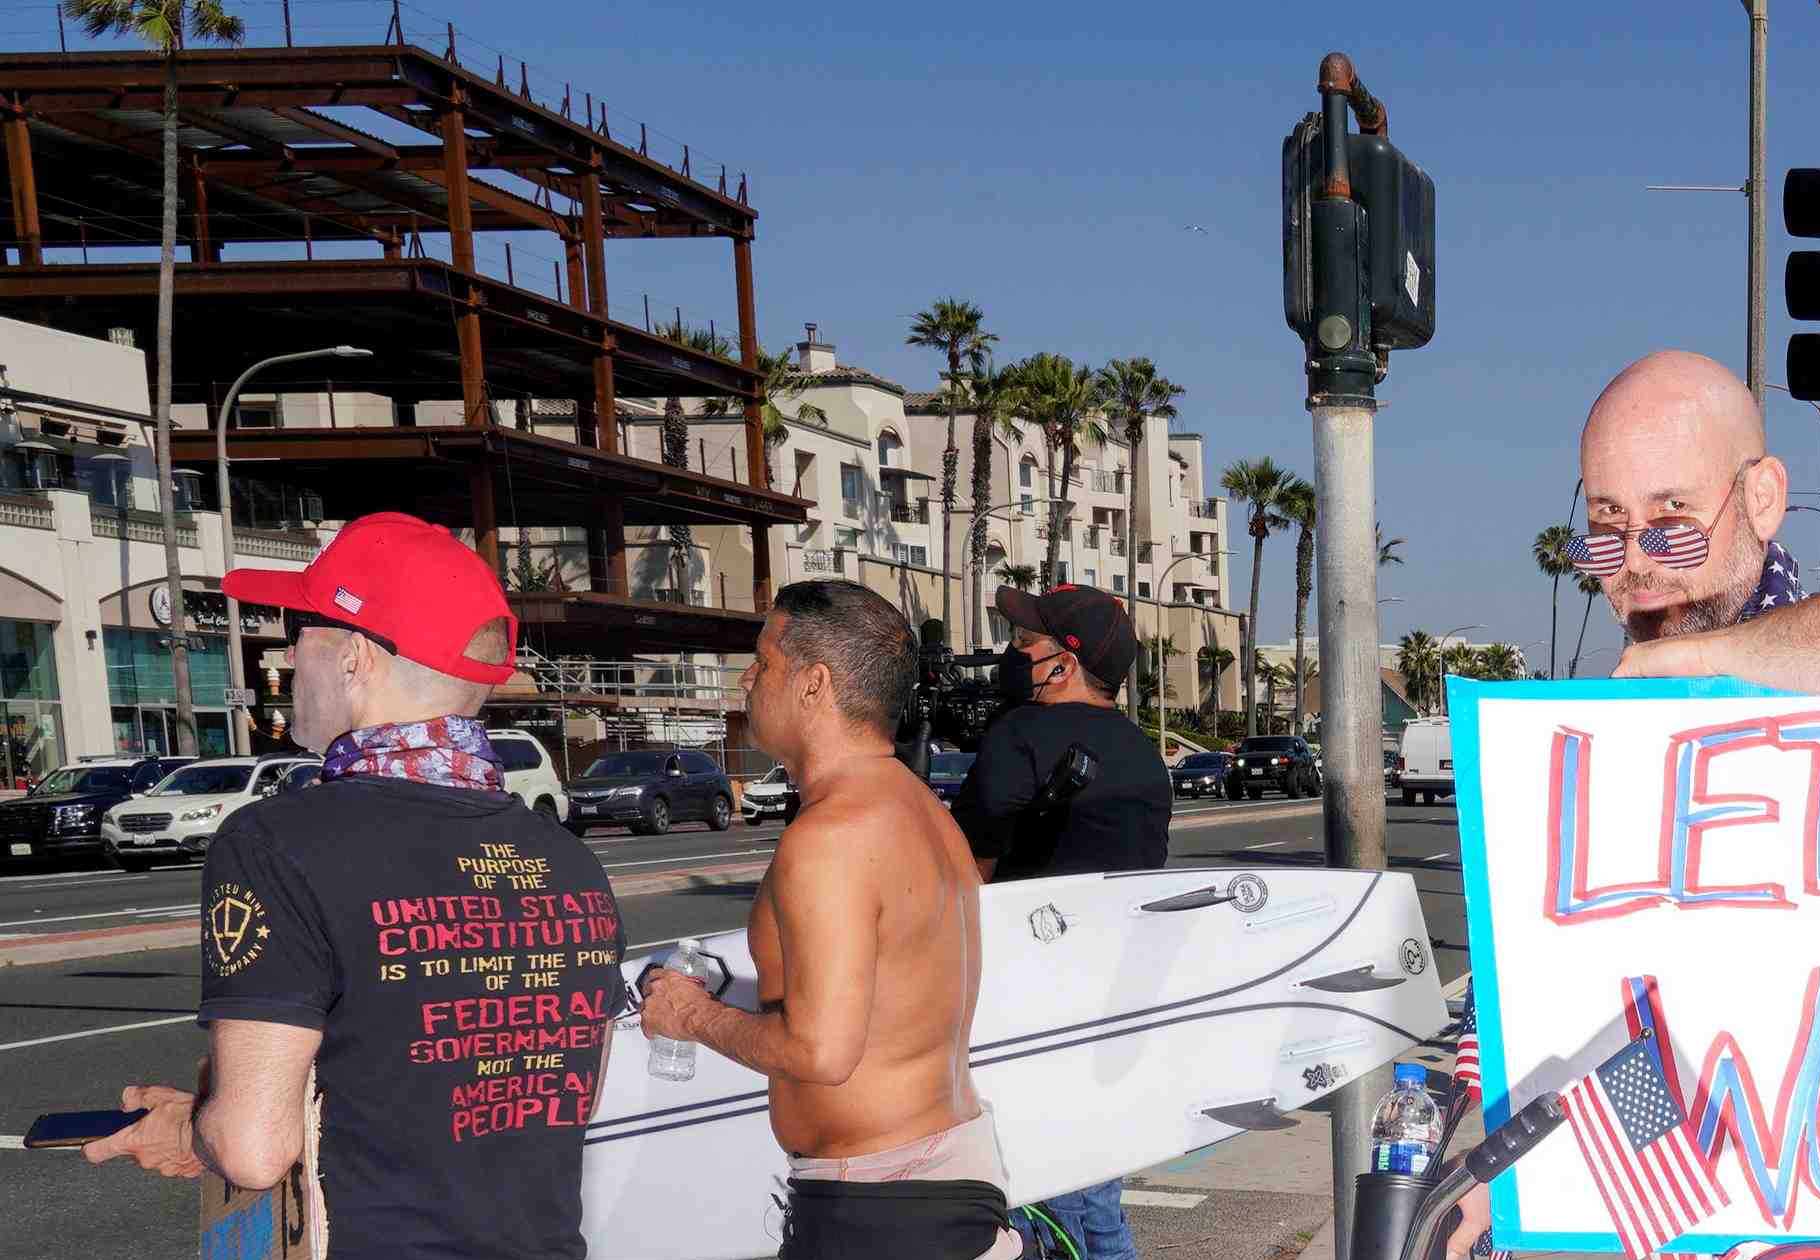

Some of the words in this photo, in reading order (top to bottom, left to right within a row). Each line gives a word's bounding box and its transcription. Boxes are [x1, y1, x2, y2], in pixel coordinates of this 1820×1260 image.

[480, 843, 519, 858] THE
[457, 857, 551, 874] PURPOSE
[473, 874, 497, 890] OF
[507, 874, 548, 890] THE
[371, 896, 501, 926] UNITED
[379, 964, 407, 981] IS
[420, 958, 449, 977] TO
[461, 955, 515, 974] LIMIT
[527, 953, 566, 969] THE
[485, 975, 511, 991] OF
[521, 971, 560, 988] THE
[421, 990, 607, 1035] FEDERAL
[476, 1057, 513, 1076] NOT
[523, 1053, 564, 1070] THE
